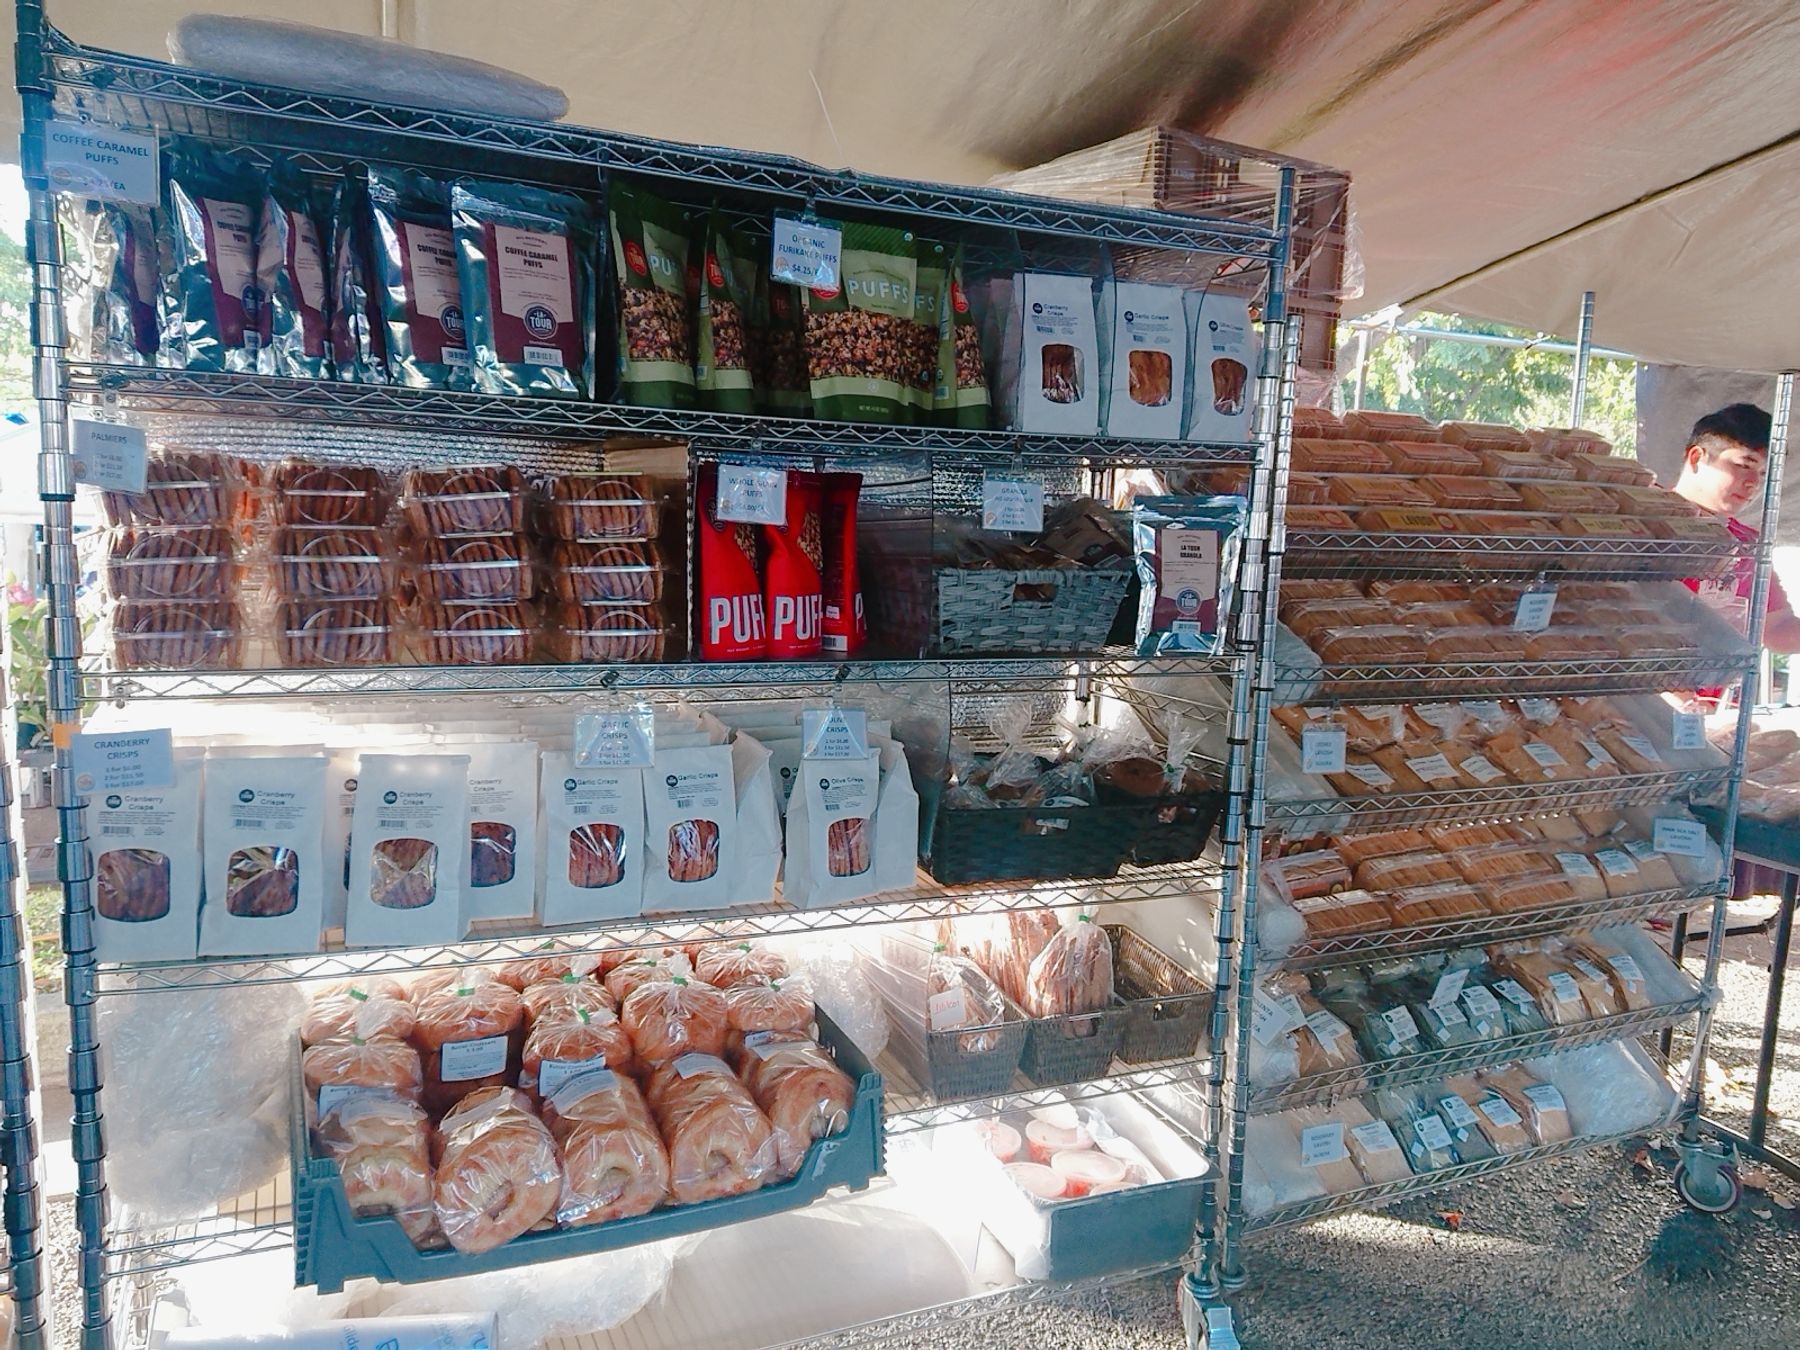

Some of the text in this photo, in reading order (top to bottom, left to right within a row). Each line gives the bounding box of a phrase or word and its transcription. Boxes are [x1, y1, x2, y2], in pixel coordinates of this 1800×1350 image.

[53, 133, 149, 157] COFFEE CARAMEL
[86, 152, 119, 165] PUFFS
[505, 246, 558, 262] COFFEE CARAMEL
[523, 259, 543, 269] PUFFS
[848, 279, 909, 304] PUFFS
[530, 316, 553, 329] TOUR
[94, 738, 150, 749] CRANBERRY
[107, 750, 139, 760] CRISPS
